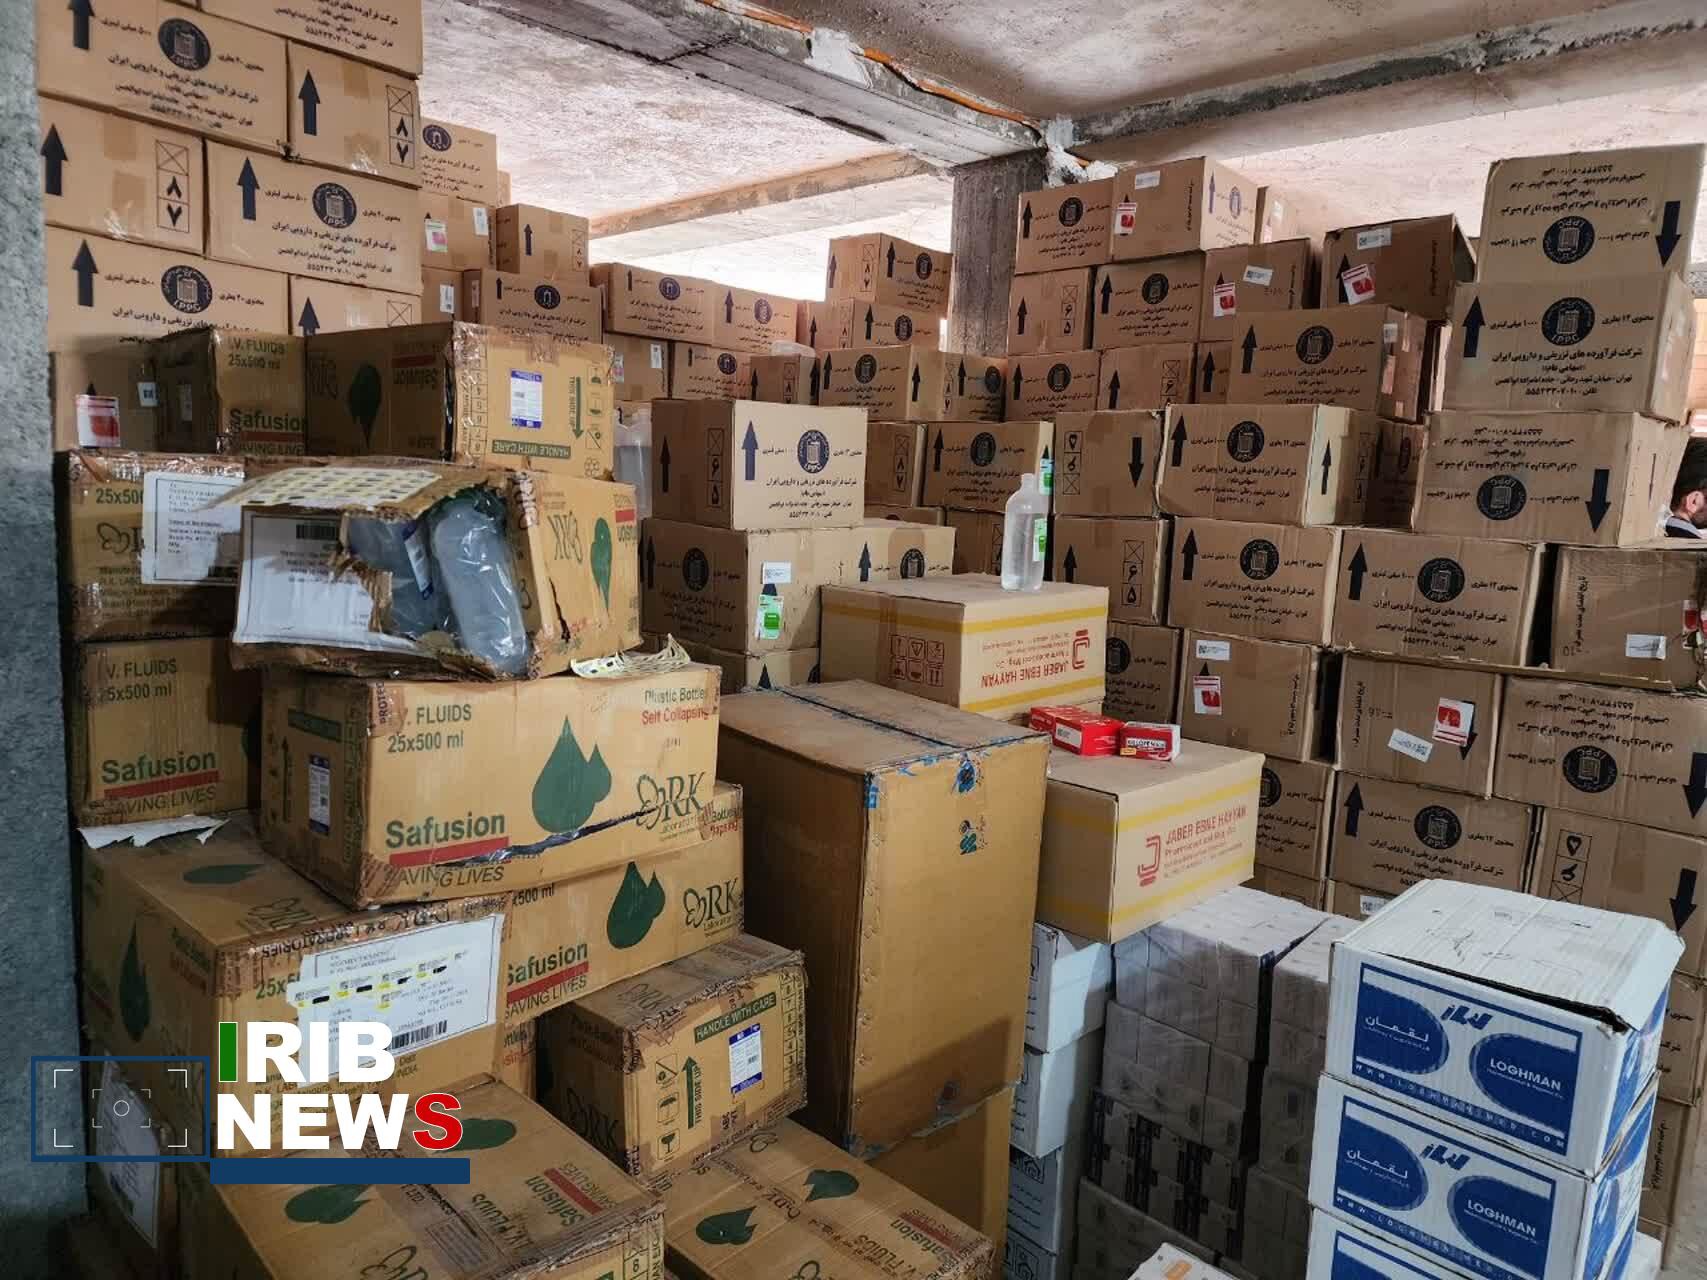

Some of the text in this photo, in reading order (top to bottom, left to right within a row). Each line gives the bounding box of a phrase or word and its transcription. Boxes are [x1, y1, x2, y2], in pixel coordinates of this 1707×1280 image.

[125, 659, 176, 677] FLUIDS
[416, 704, 472, 725] FLUIDS
[388, 731, 463, 753] 25x500 ml
[102, 751, 216, 783] Safusion
[116, 787, 216, 815] AVING LIVES
[385, 812, 505, 849] Safusion
[1166, 824, 1193, 844] JABER
[397, 865, 505, 887] AVING LIVES
[696, 994, 776, 1040] HANDLE WITH CARE
[1365, 1015, 1429, 1042] لقمان
[1490, 1058, 1561, 1091] LOGHMAN
[1347, 1149, 1408, 1180] لقمان
[1467, 1199, 1536, 1236] LOGHMAN
